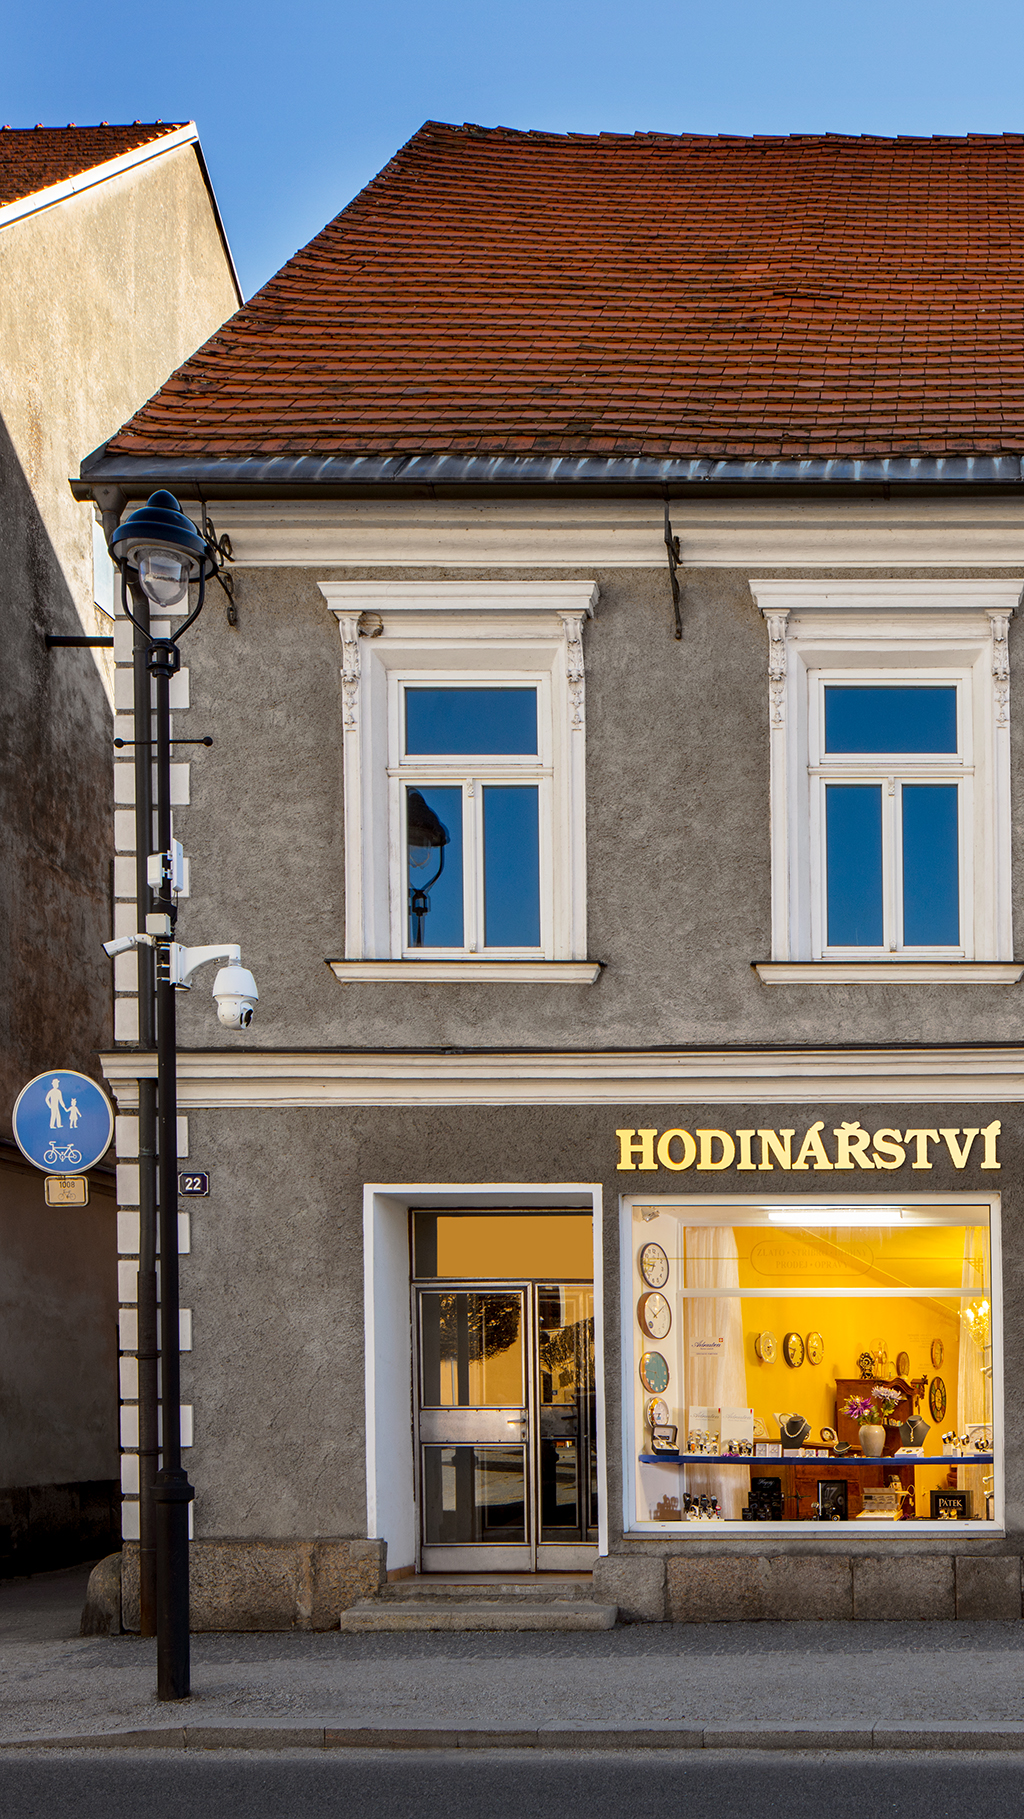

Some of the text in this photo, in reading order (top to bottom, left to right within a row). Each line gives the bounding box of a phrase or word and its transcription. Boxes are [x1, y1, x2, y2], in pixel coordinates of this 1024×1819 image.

[616, 1120, 1001, 1171] HODINÁŘSTVÍ
[59, 1181, 75, 1189] 1008
[185, 1177, 201, 1191] 22
[757, 1248, 785, 1257] ZLATO
[776, 1260, 849, 1269] PRODEJ OPRAVY
[938, 1497, 963, 1507] PÁTEK
